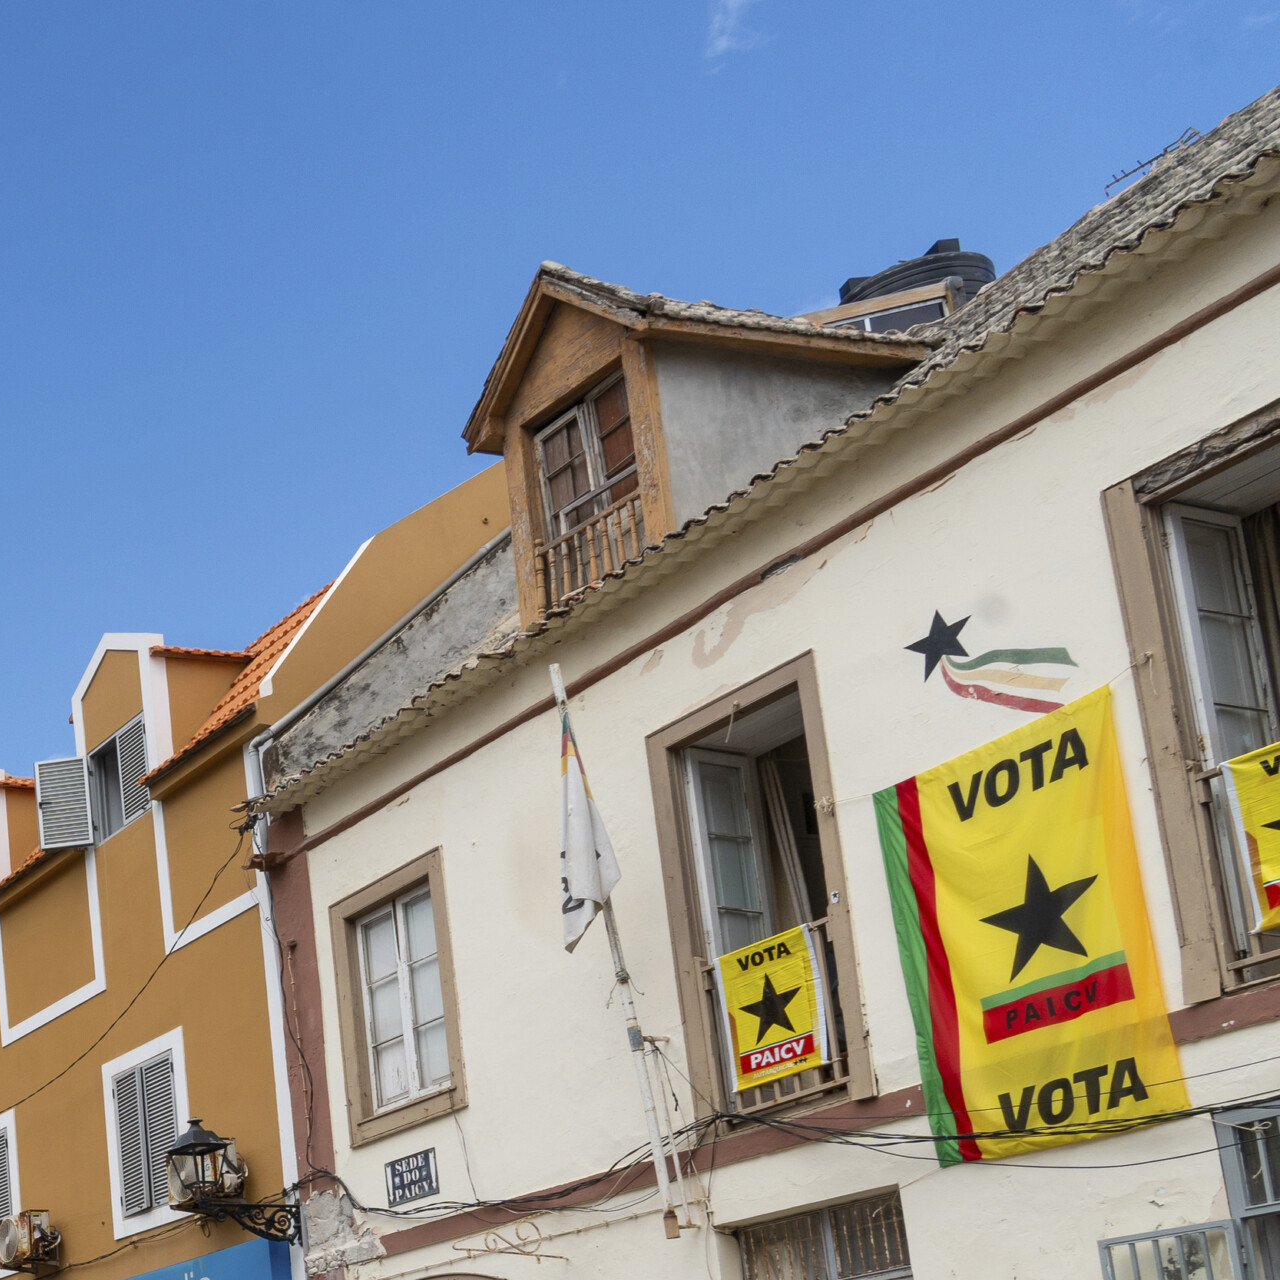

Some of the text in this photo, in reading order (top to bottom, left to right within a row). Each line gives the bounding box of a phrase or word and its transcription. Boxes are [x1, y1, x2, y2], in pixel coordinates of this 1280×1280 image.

[947, 727, 1089, 822] VOTA
[736, 941, 792, 971] VOTA
[1005, 981, 1099, 1030] PAICV
[750, 1038, 805, 1069] PAICV
[998, 1056, 1149, 1134] VOTA
[394, 1153, 425, 1175] SEDE
[403, 1169, 420, 1185] DO
[395, 1180, 430, 1201] PAICV
